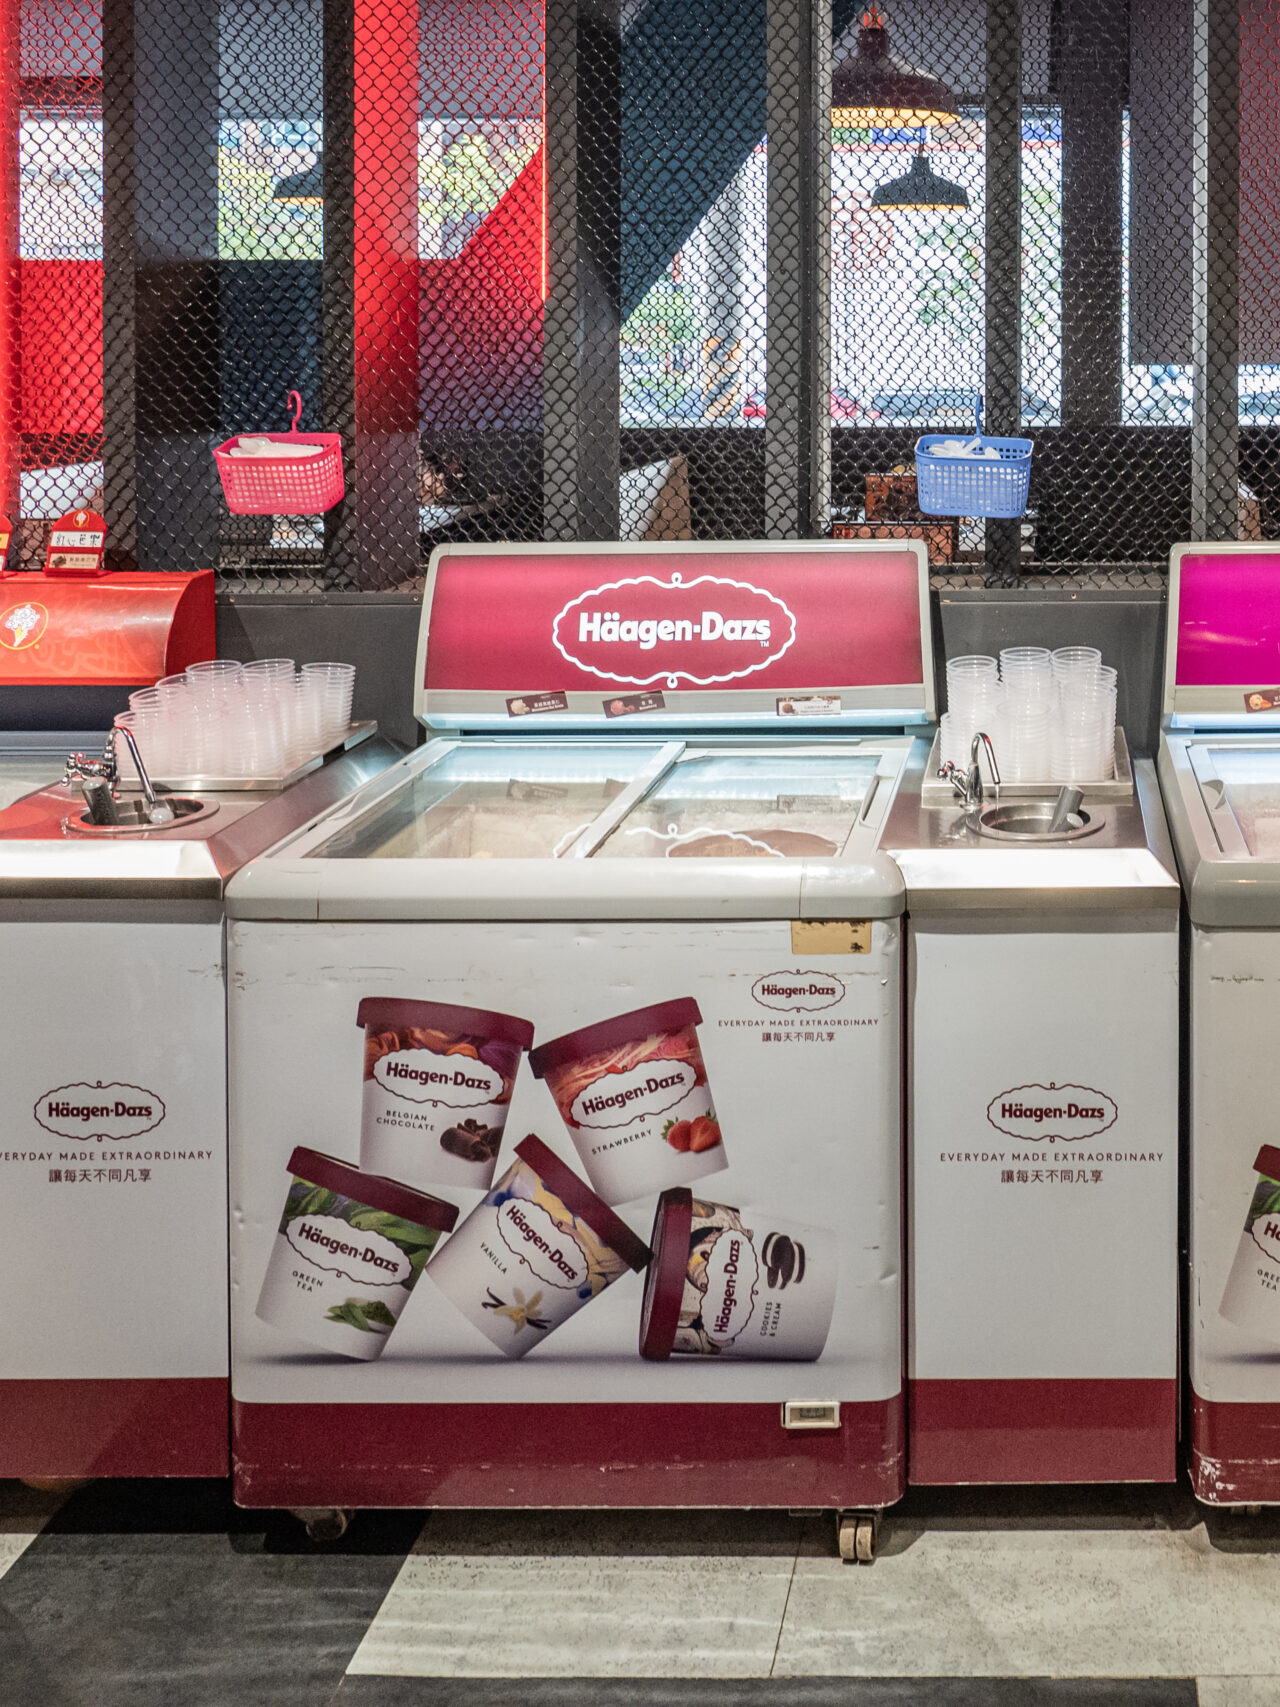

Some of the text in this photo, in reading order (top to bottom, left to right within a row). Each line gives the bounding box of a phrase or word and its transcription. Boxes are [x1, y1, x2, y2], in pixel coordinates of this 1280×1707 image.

[579, 611, 771, 650] Häagen-Dazs
[762, 984, 836, 998] Häagen-Dazs
[800, 1018, 879, 1026] EXTRAORDINARY
[385, 1062, 491, 1091] Häagen-Dazs
[581, 1072, 685, 1116] Häagen-Dazs
[48, 1102, 152, 1122] Häagen-Dazs
[386, 1110, 428, 1122] BELGIAN
[1001, 1103, 1105, 1123] Häagen-Dazs
[376, 1117, 435, 1132] CHOCOLATE
[592, 1129, 653, 1155] STRAWBERRY
[0, 1150, 213, 1161] ERYDAY MADE EXTRAORDINARY
[940, 1152, 1164, 1162] EVERYDAY MADE EXTRAORDINARY
[49, 1168, 152, 1183] 讓每天不同凡享
[1001, 1170, 1104, 1183] 讓每天不同凡享
[297, 1222, 400, 1274] Häagen-Dazs
[505, 1205, 578, 1281] Häagen-Dazs
[479, 1241, 508, 1275] VANILLA
[292, 1270, 323, 1288] GREEN
[296, 1281, 313, 1293] TEA
[714, 1239, 741, 1334] Häagen-Dazs
[1261, 1280, 1277, 1292] TEA
[760, 1301, 773, 1337] COOKIES
[770, 1302, 782, 1330] CREAM
